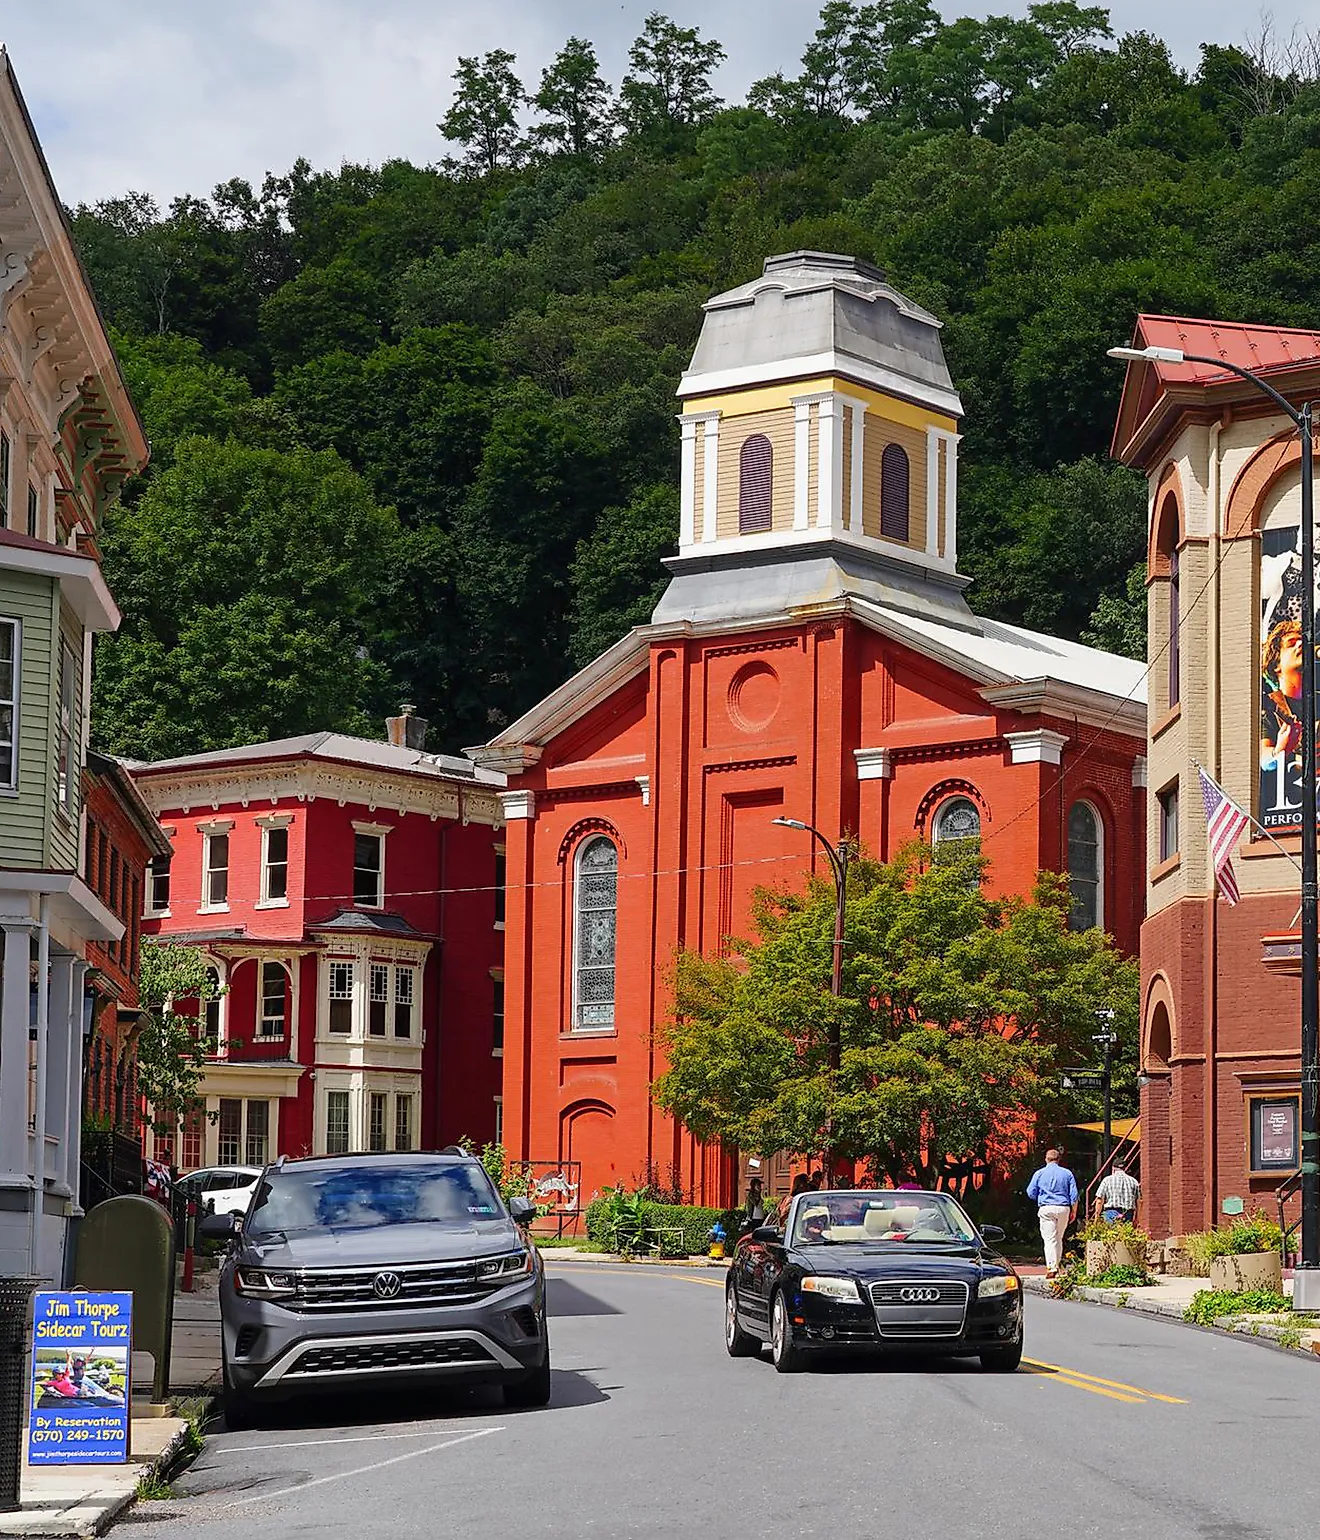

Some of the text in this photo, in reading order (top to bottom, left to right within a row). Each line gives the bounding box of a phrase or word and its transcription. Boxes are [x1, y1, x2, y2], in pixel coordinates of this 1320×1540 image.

[46, 1300, 119, 1320] Jim Thorpe
[37, 1321, 127, 1337] Sidecar Tourz
[36, 1416, 121, 1429] By Reservation
[31, 1429, 125, 1443] (570) 249-1570
